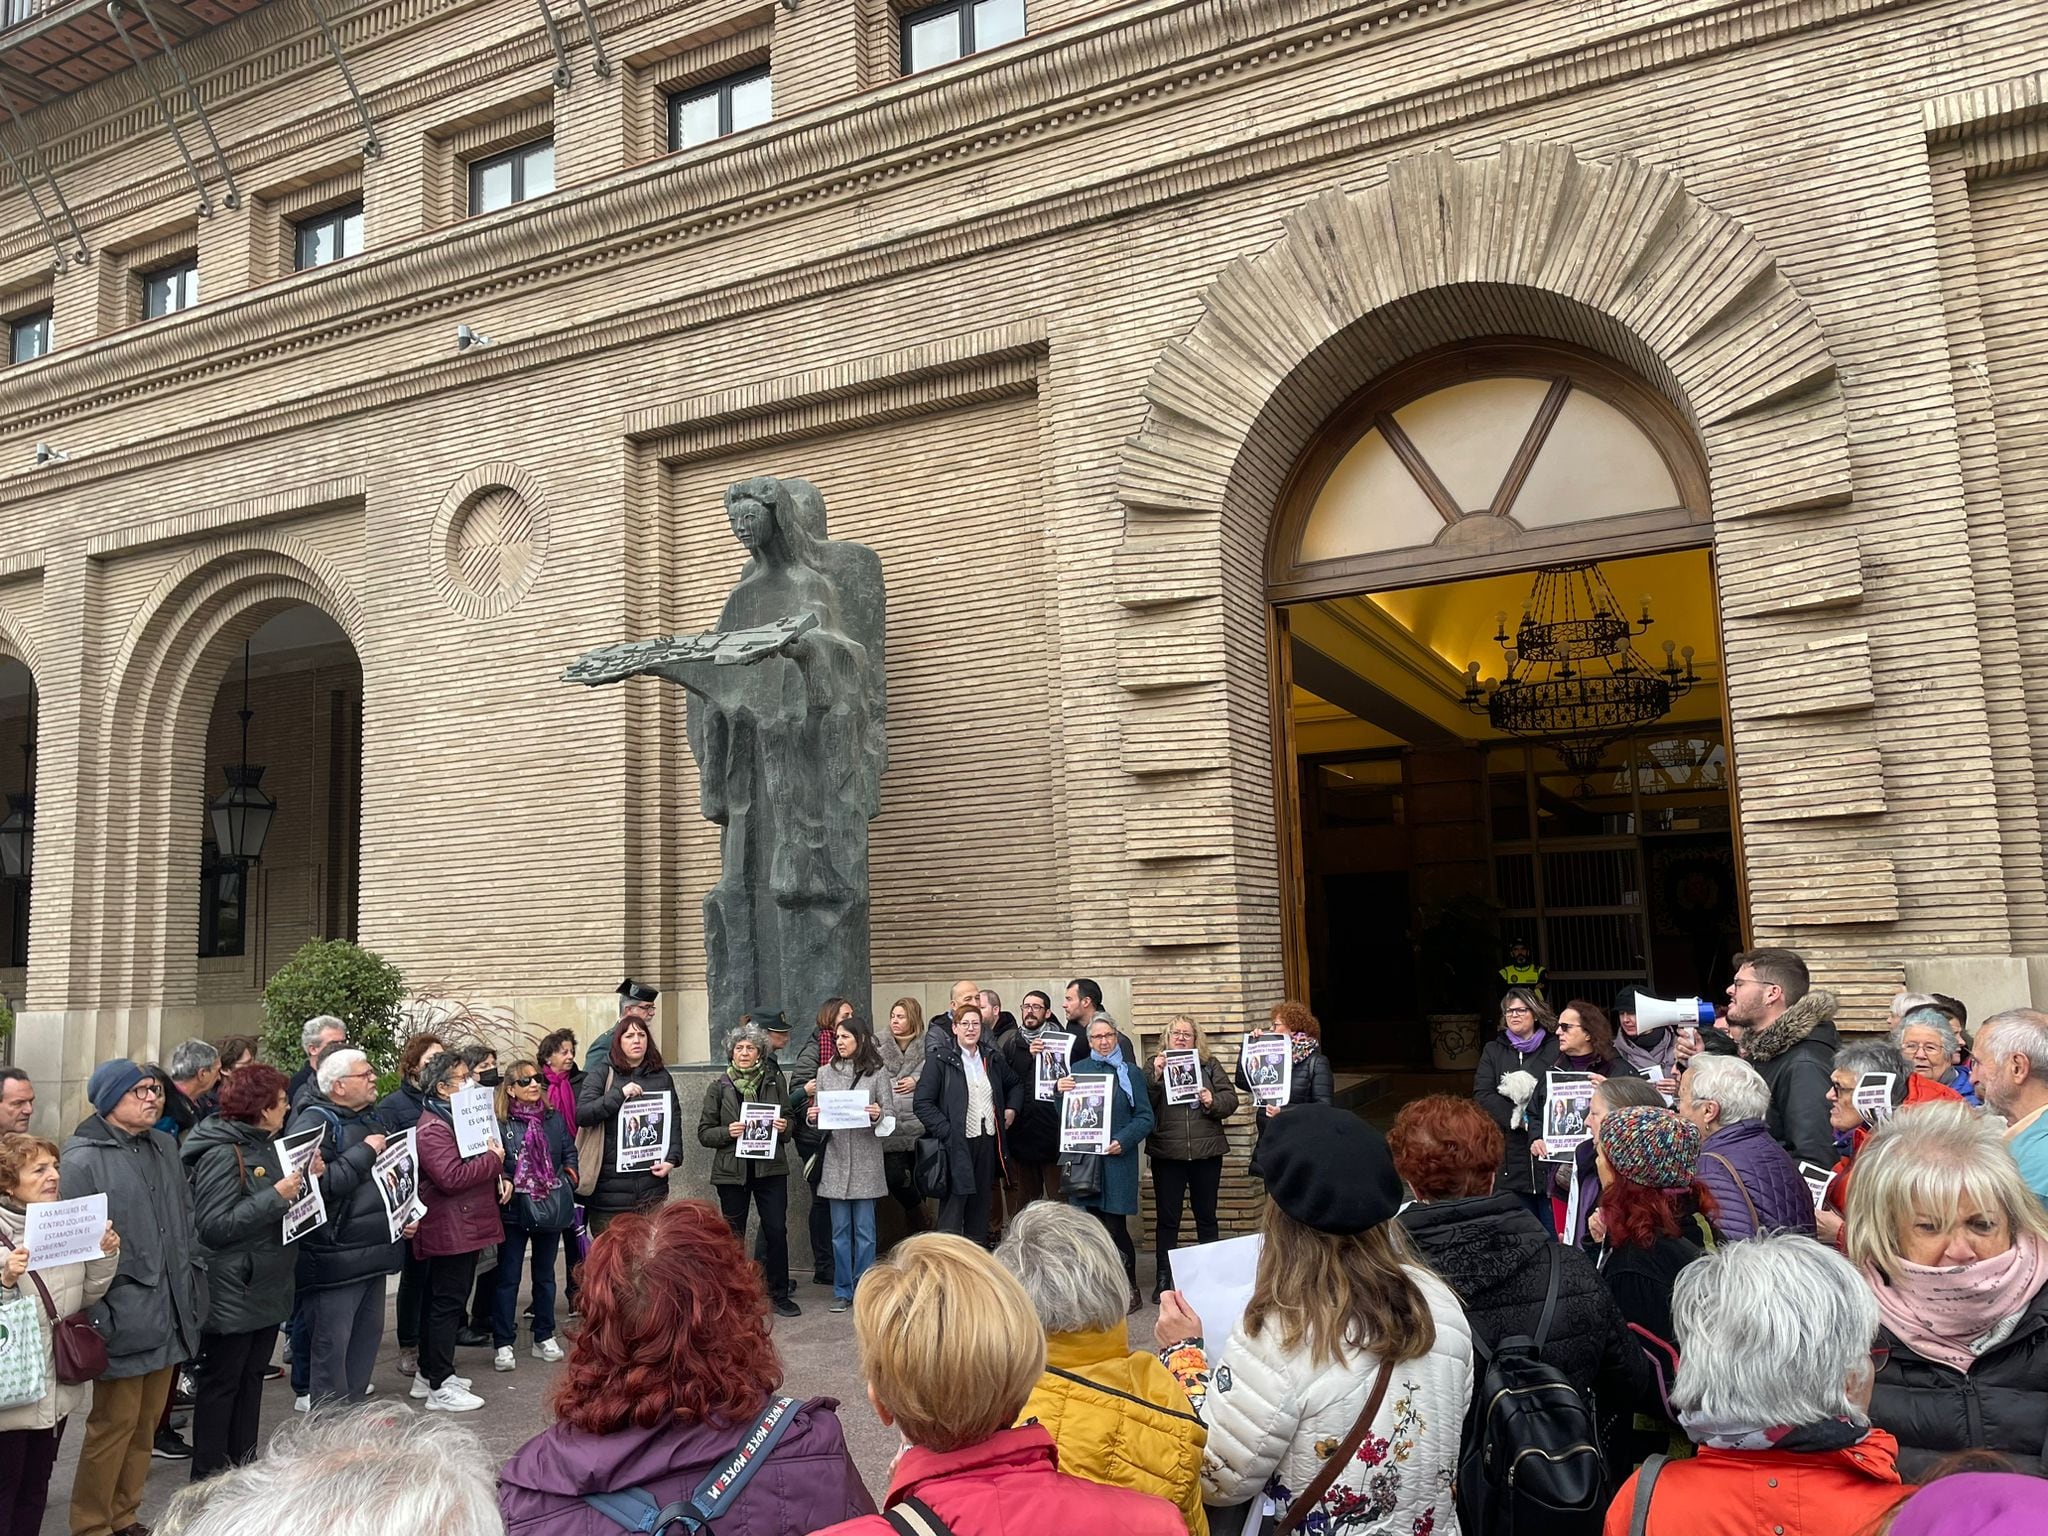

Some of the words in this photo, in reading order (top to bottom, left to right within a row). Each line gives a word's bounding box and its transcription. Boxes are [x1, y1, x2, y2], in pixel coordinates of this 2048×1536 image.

[476, 1116, 485, 1124] UN
[482, 1127, 490, 1135] DE
[467, 1141, 486, 1151] LUCHA
[40, 1210, 53, 1218] LAS
[53, 1206, 79, 1216] MUJERES
[80, 1204, 88, 1212] DE
[38, 1221, 65, 1230] CENTRO
[65, 1215, 97, 1226] IZQUIERDA
[44, 1230, 74, 1241] ESTAMOS
[34, 1241, 68, 1253] GOBIERNO
[69, 1246, 93, 1256] PROPIO
